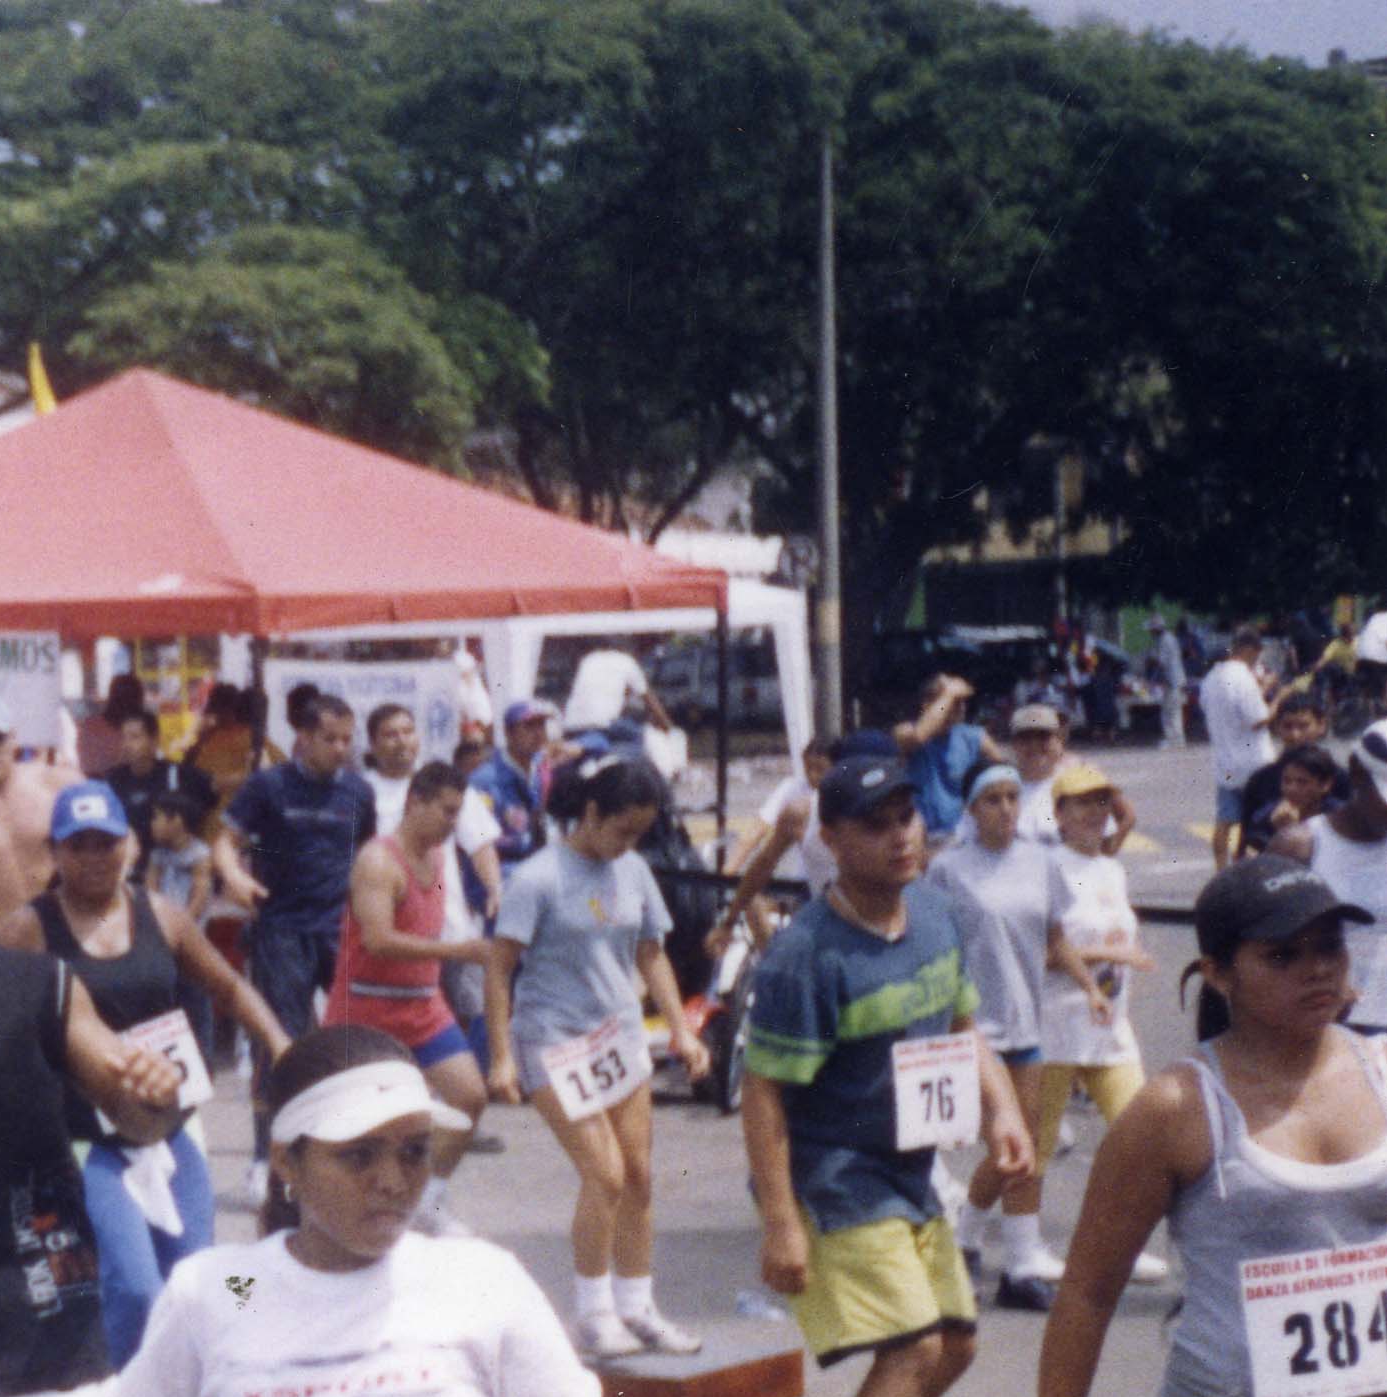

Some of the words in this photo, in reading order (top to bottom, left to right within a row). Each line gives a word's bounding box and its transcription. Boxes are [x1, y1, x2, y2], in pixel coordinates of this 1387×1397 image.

[566, 1047, 627, 1101] 153
[919, 1076, 955, 1122] 76
[1284, 1289, 1387, 1376] 284
